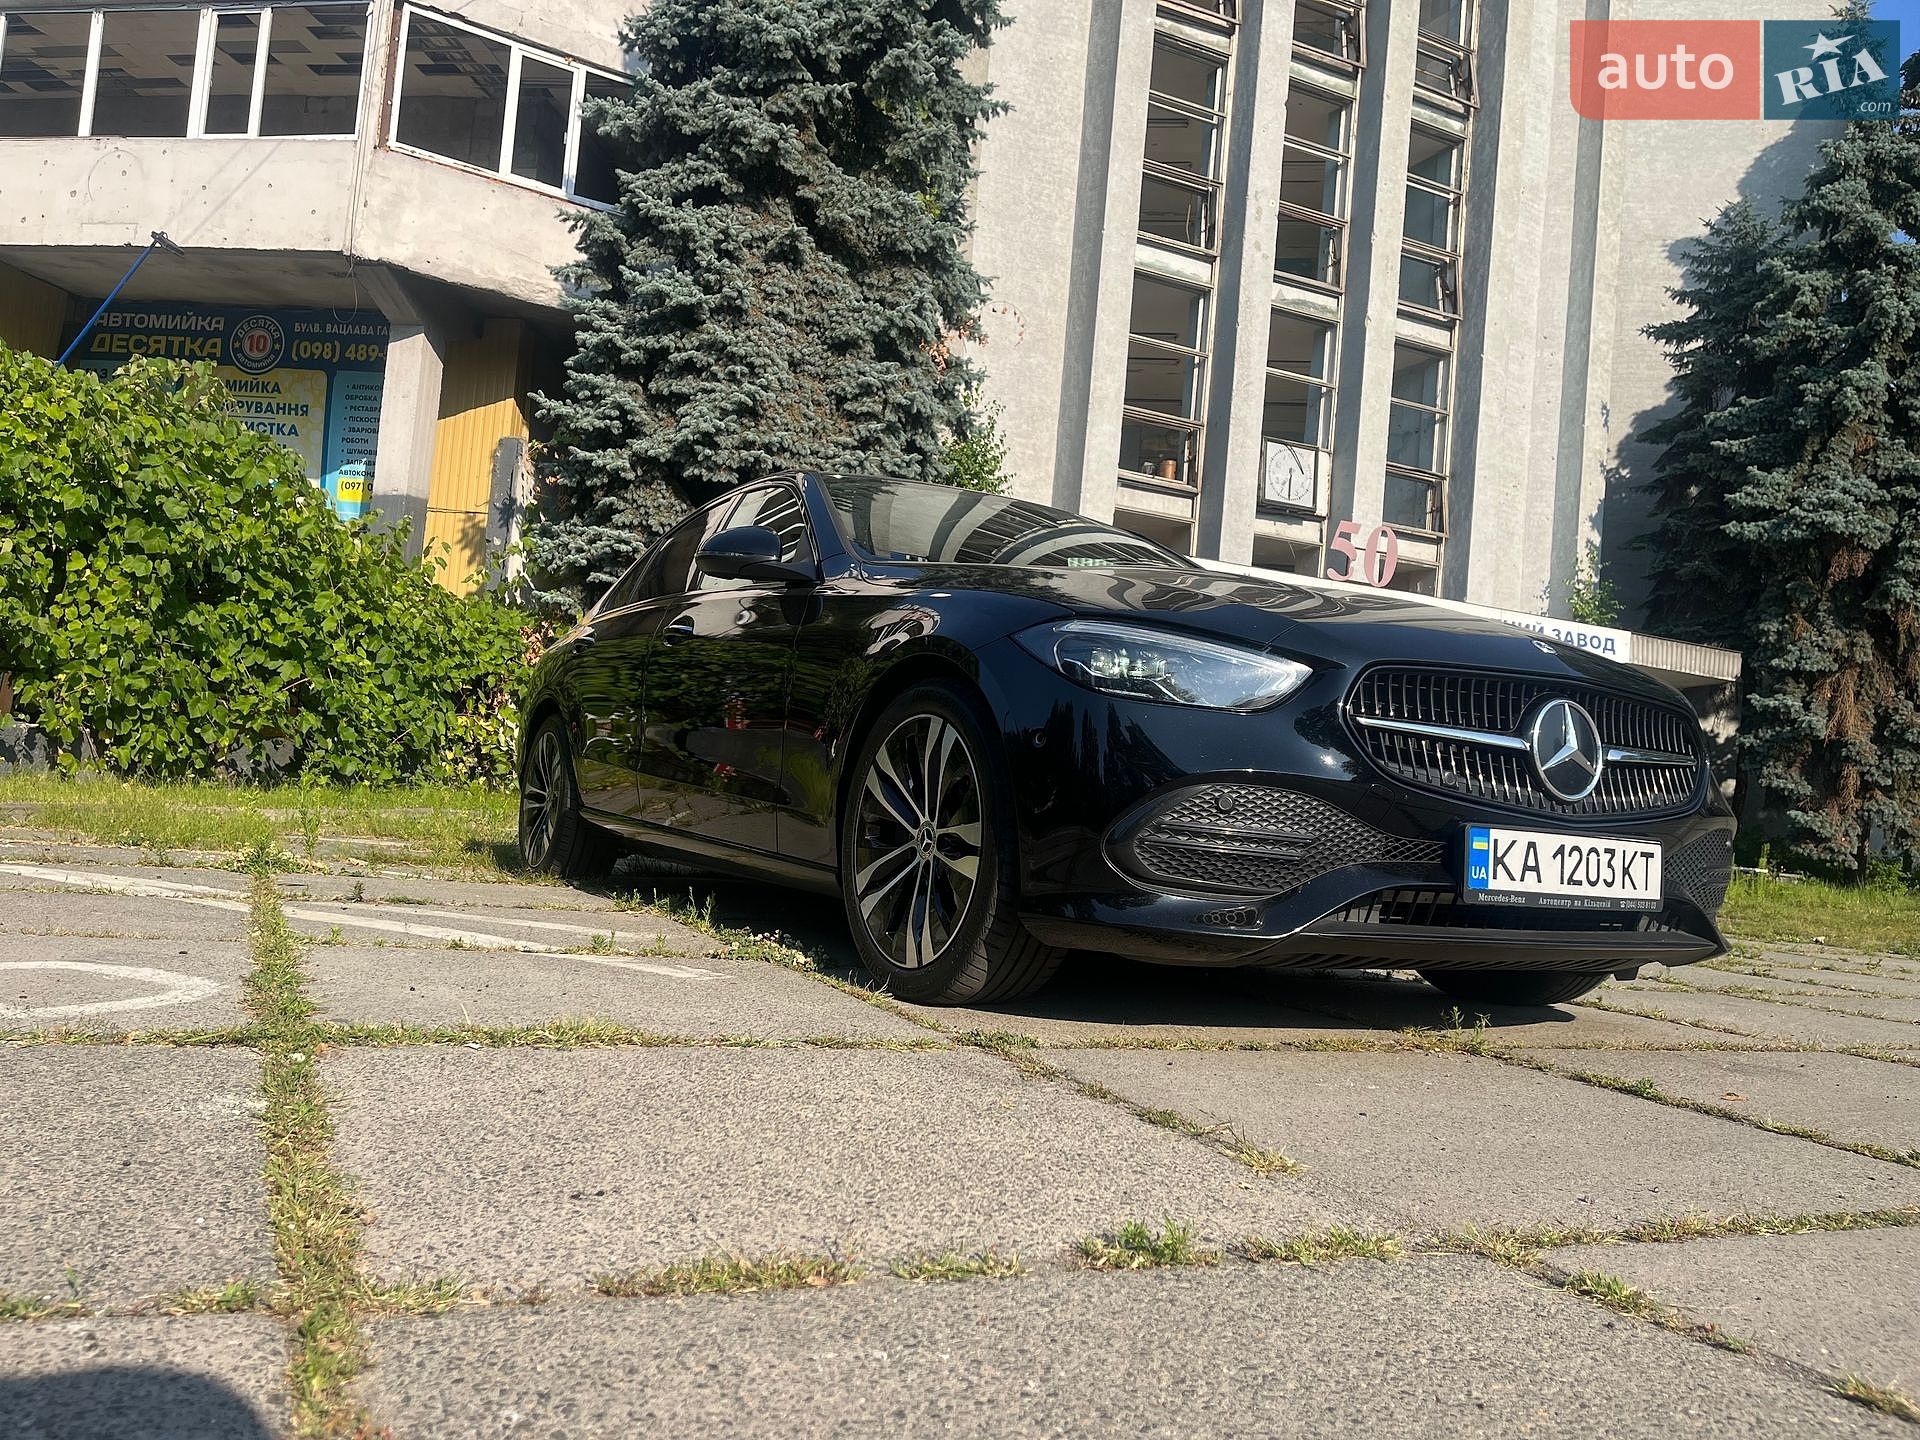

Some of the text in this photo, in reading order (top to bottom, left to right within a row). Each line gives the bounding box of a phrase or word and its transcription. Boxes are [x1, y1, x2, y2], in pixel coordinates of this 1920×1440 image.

[94, 311, 225, 331] АВТОМИЙКА
[237, 318, 281, 340] ДЕСЯТКА
[294, 323, 322, 333] БУЛВ.
[326, 323, 375, 336] ВАЦЛАВА
[90, 333, 222, 357] ДЕСЯТКА
[247, 334, 269, 354] 10
[291, 340, 387, 363] (098) 489-
[344, 394, 378, 402] ОБРОБКА
[242, 421, 299, 437] ИСТКА
[341, 481, 365, 493] (097)
[1326, 520, 1399, 588] 50
[1552, 628, 1617, 655] ЗАВОД
[1471, 866, 1488, 880] UA
[1492, 838, 1655, 892] KA 1203 KT
[1478, 893, 1527, 904] Mercedes-Benz
